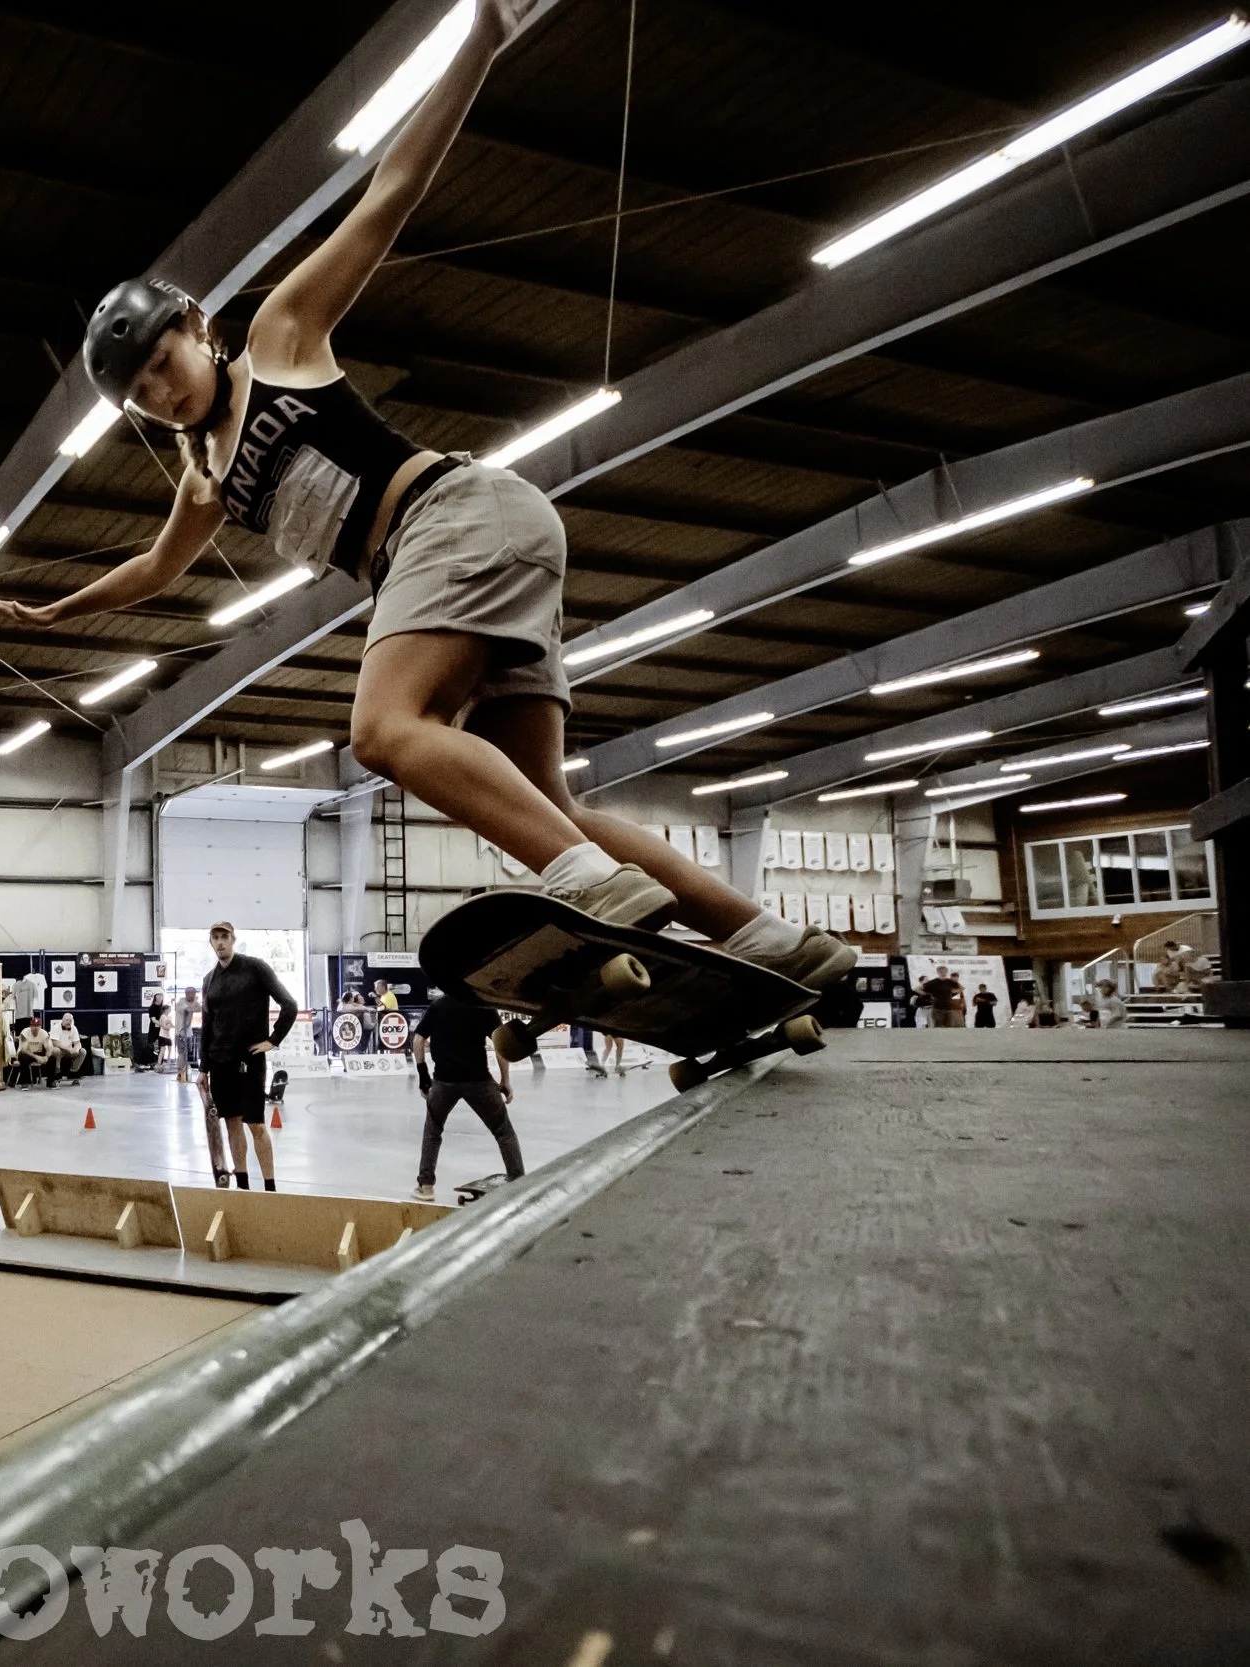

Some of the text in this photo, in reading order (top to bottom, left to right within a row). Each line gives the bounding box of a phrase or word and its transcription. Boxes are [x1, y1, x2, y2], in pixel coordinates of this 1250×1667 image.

[226, 395, 318, 527] ANADA
[334, 1014, 360, 1029] POWELL
[381, 1025, 406, 1034] BONES
[335, 1034, 361, 1049] PERALTA
